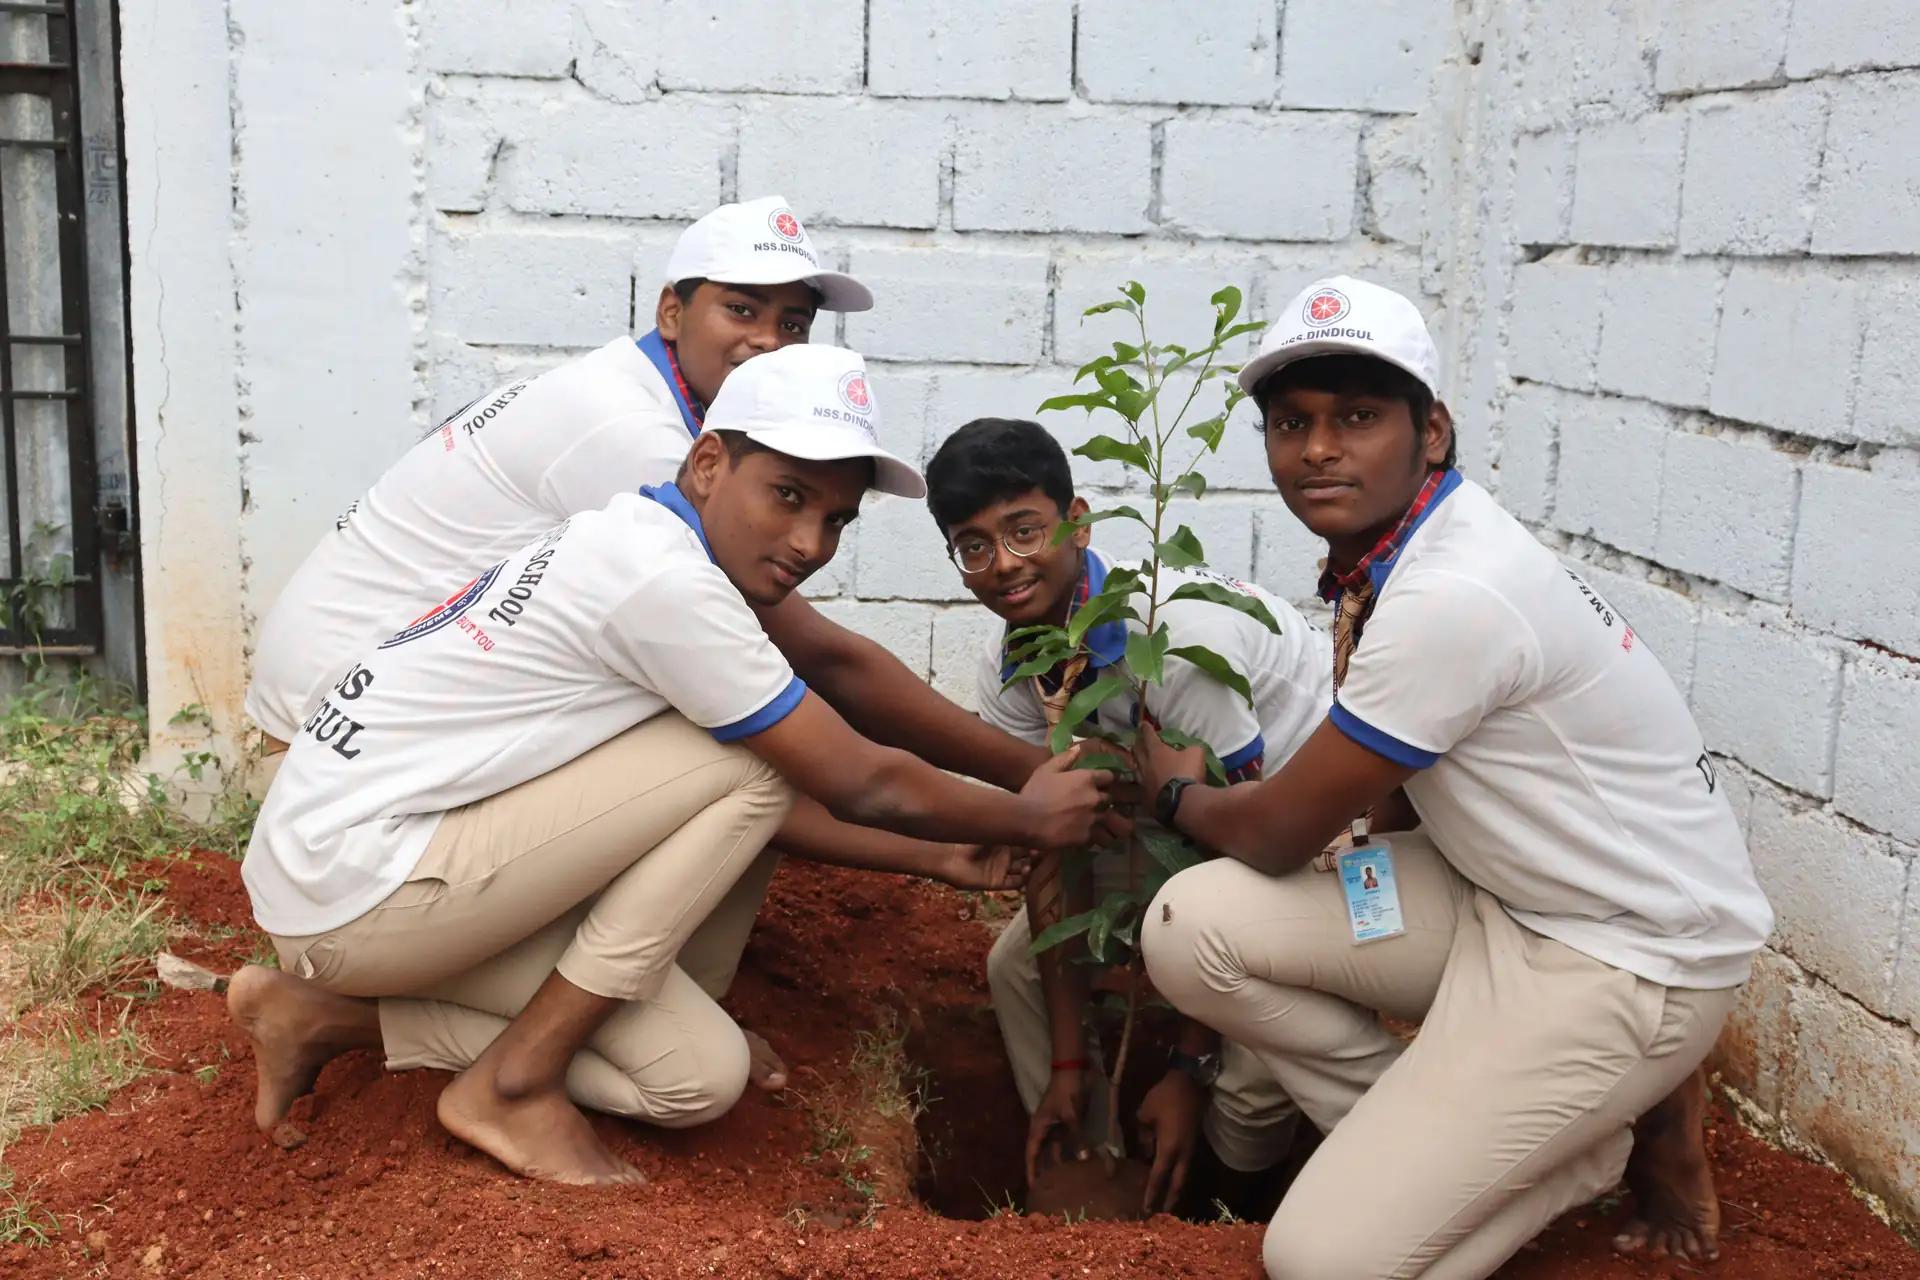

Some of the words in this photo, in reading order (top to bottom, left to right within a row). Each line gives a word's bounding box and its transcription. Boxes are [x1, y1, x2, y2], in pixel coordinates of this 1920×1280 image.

[463, 384, 527, 436] SCHOOL
[488, 549, 555, 627] SCHOOL
[472, 629, 495, 651] YOU
